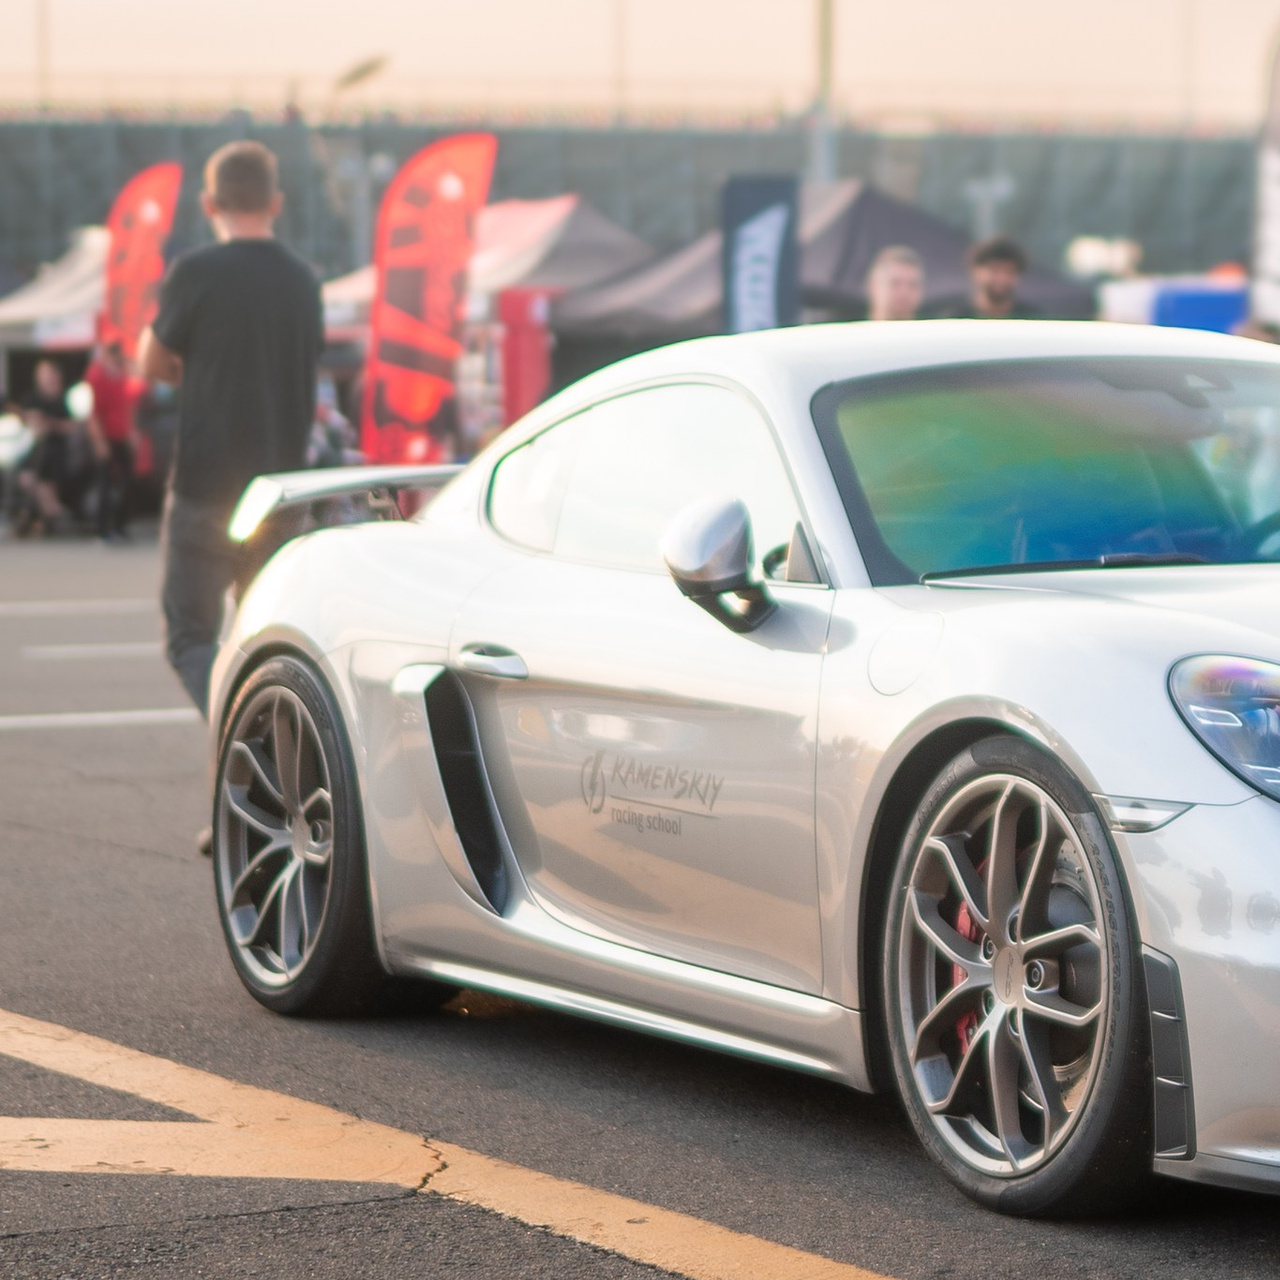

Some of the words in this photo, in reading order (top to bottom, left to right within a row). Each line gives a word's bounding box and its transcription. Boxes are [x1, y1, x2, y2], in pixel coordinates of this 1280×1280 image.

[611, 755, 725, 812] KAMENSKIY
[611, 806, 644, 833] racing
[646, 814, 682, 836] school
